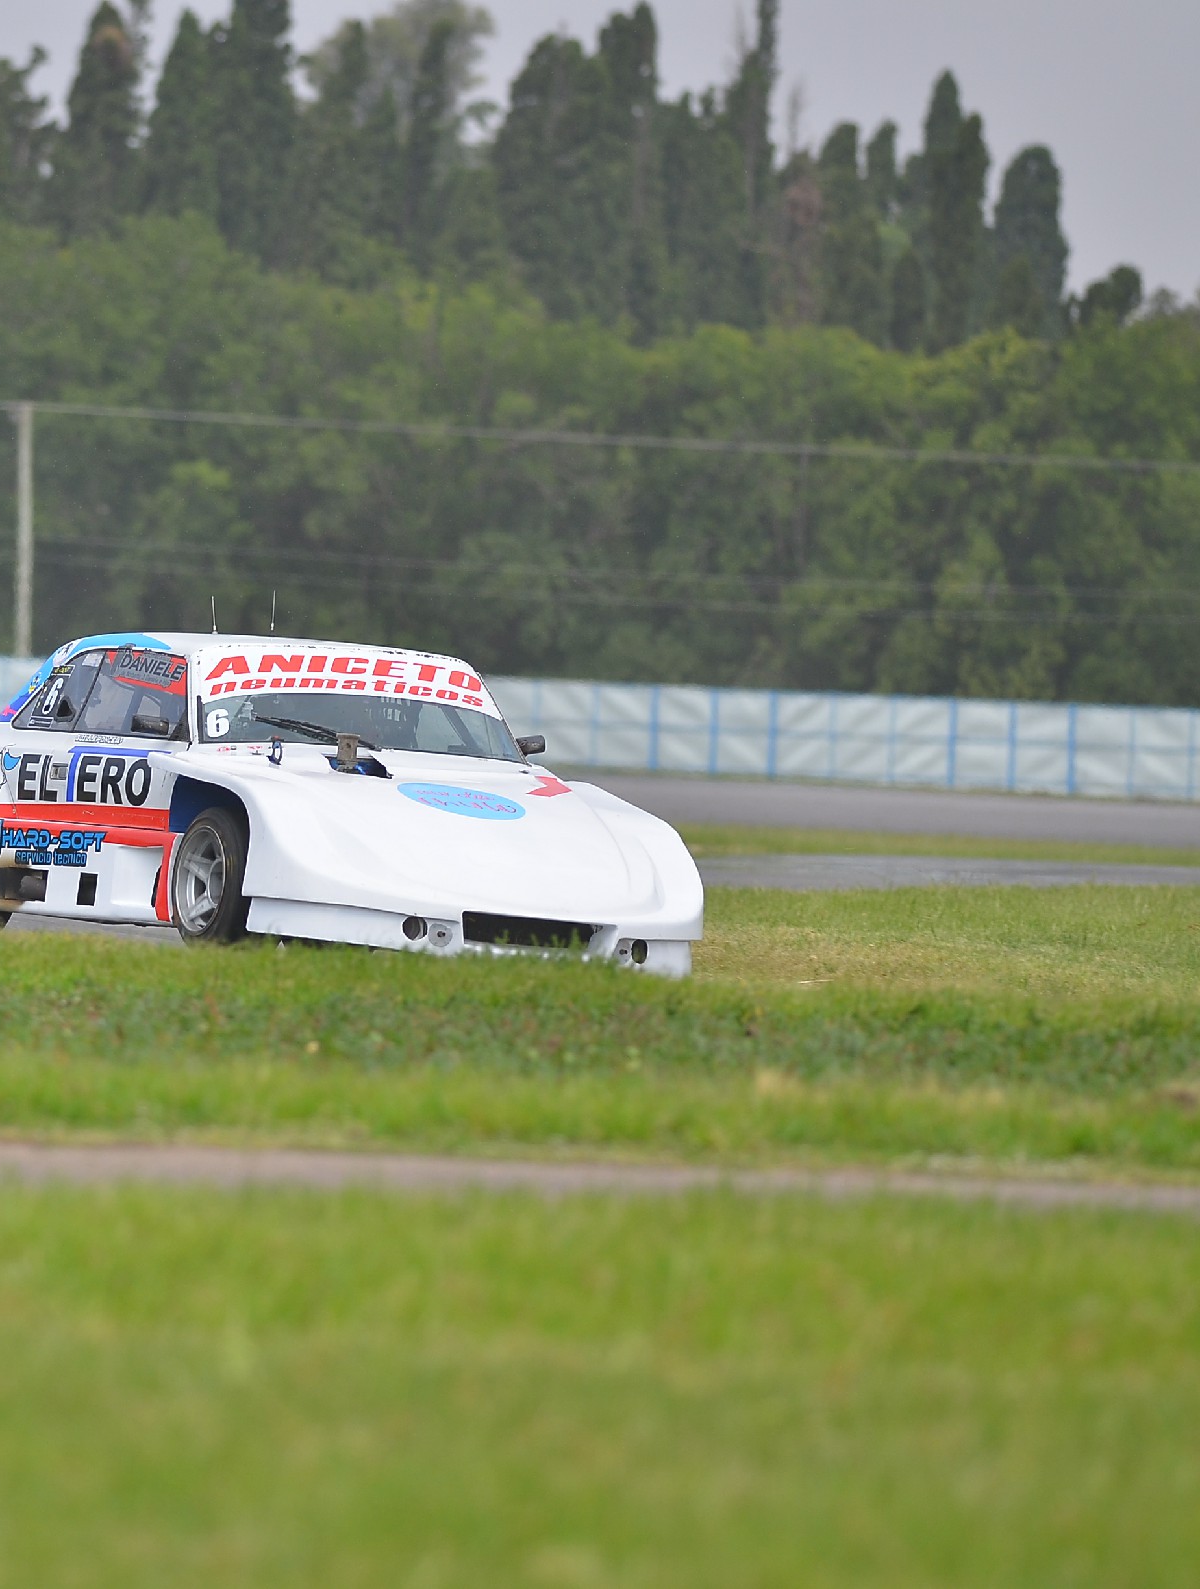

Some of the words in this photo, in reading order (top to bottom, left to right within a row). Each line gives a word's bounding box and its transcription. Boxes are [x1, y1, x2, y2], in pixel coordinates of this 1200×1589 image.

[120, 653, 186, 681] DANIELE
[205, 654, 482, 692] ANICETO
[42, 677, 64, 714] 6
[209, 677, 483, 707] neumaticos
[206, 708, 230, 738] 6
[18, 754, 58, 802] EL
[67, 745, 172, 806] TERO
[1, 828, 107, 851] HARD-SOFT
[15, 850, 53, 865] servicio
[53, 852, 88, 867] tecnico
